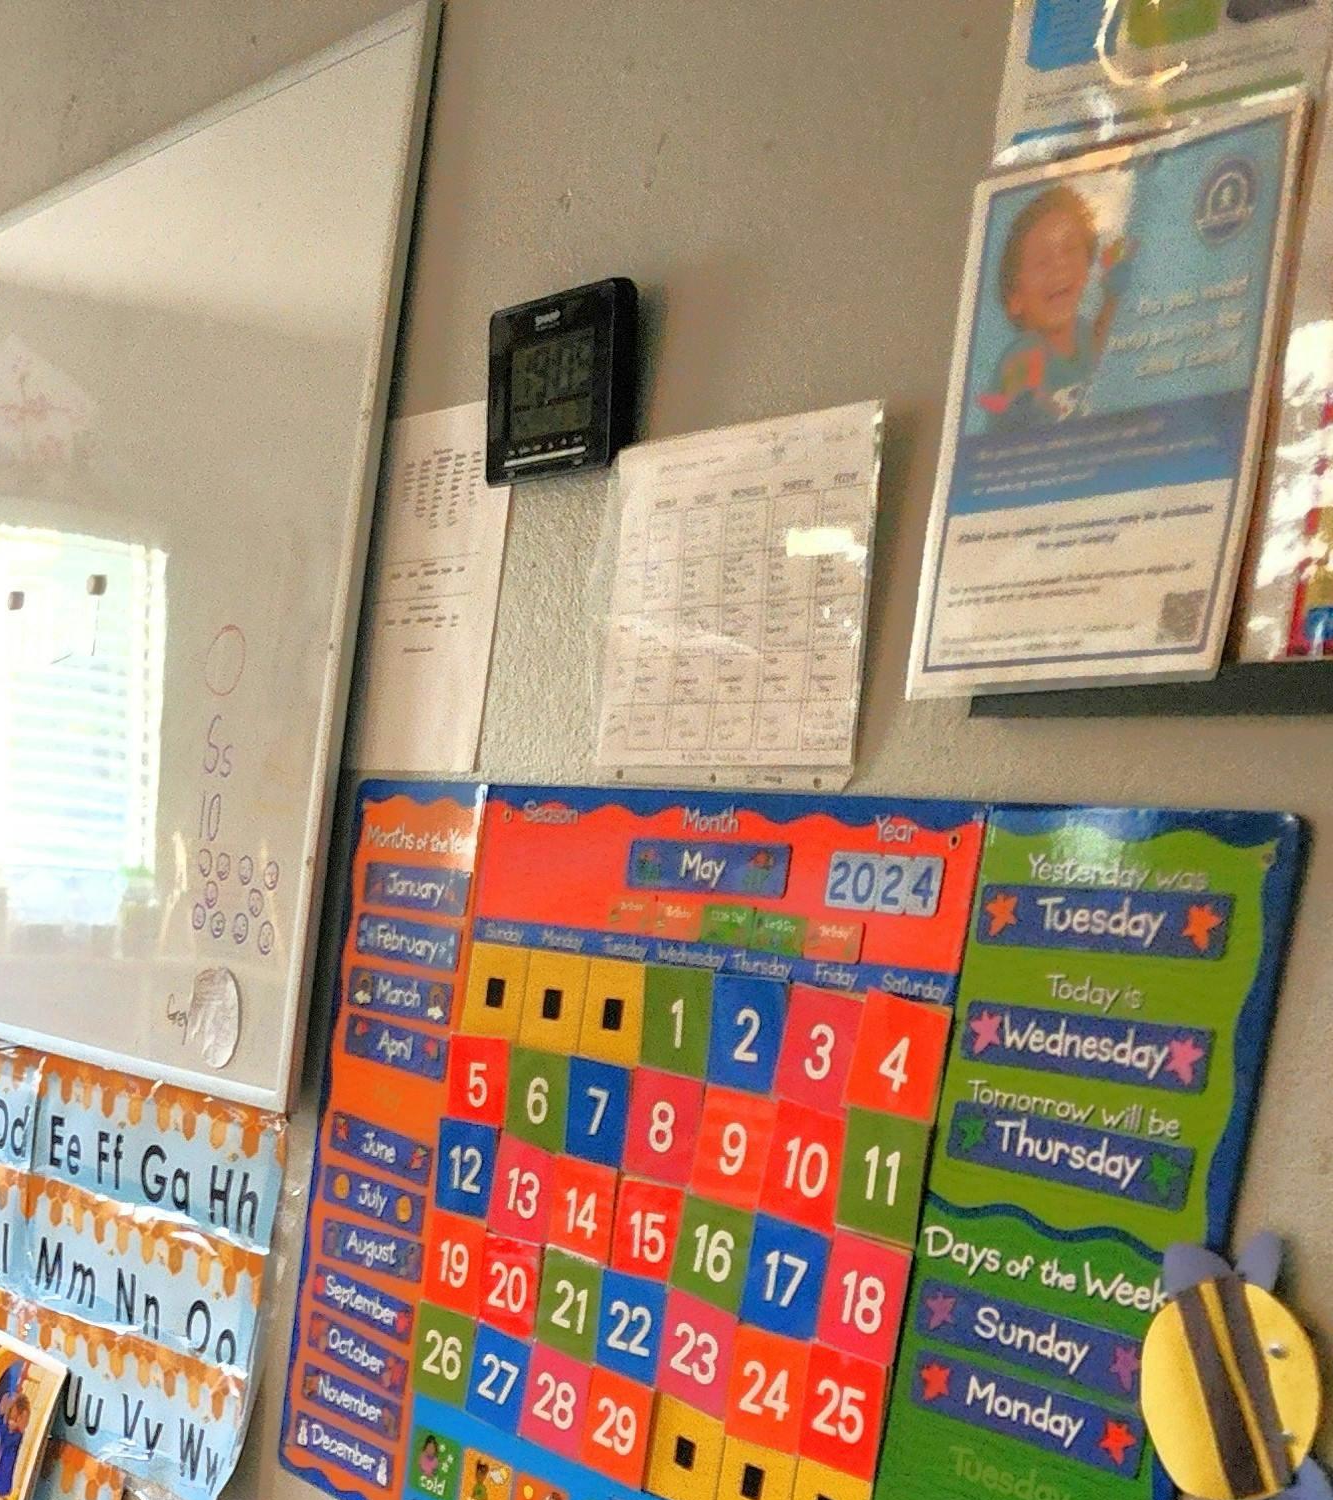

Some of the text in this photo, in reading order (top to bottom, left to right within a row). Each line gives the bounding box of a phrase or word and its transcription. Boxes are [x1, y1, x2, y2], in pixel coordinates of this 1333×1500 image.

[199, 790, 221, 841] 10
[366, 822, 414, 850] Months
[416, 831, 429, 850] of
[431, 831, 448, 852] the
[522, 800, 579, 824] Season
[682, 807, 738, 834] Month
[875, 815, 918, 844] Year
[387, 872, 444, 907] January
[680, 851, 727, 888] May
[831, 860, 935, 902] 2024
[1029, 852, 1207, 892] Yesterday was
[376, 924, 439, 963] February
[1038, 897, 1164, 947] Tuesday
[486, 922, 949, 1005] Sunday Monday Tuesday Wednesday Thursday Friday Saturday
[376, 977, 421, 1008] March
[1046, 973, 1143, 1013] Today is
[377, 1029, 413, 1062] April
[670, 999, 911, 1093] 1 2 3 4
[1002, 1014, 1169, 1080] Wednesday
[468, 1062, 899, 1206] 5 6 7 8 9 10 11
[968, 1079, 1181, 1139] Tomorrow will be
[361, 1132, 396, 1165] June
[995, 1118, 1143, 1188] Thursday
[50, 1115, 82, 1175] Ee
[96, 1131, 124, 1190] Ff
[210, 1165, 258, 1239] Hh
[358, 1182, 387, 1216] July
[346, 1229, 397, 1268] August
[448, 1147, 886, 1335] 12 13 14 15 16 17 18
[924, 1225, 1168, 1312] Days of the Week
[36, 1237, 236, 1364] Mm Nn Oo
[324, 1275, 397, 1326] September
[328, 1328, 385, 1374] October
[438, 1240, 865, 1445] 19 20 21 22 23 24 25
[975, 1306, 1089, 1373] Sunday
[318, 1376, 382, 1424] November
[421, 1329, 636, 1457] 26 27 28 29
[967, 1376, 1084, 1448] Monday
[64, 1369, 225, 1496] Uu Vv Ww
[310, 1423, 377, 1475] December
[419, 1475, 446, 1496] cold
